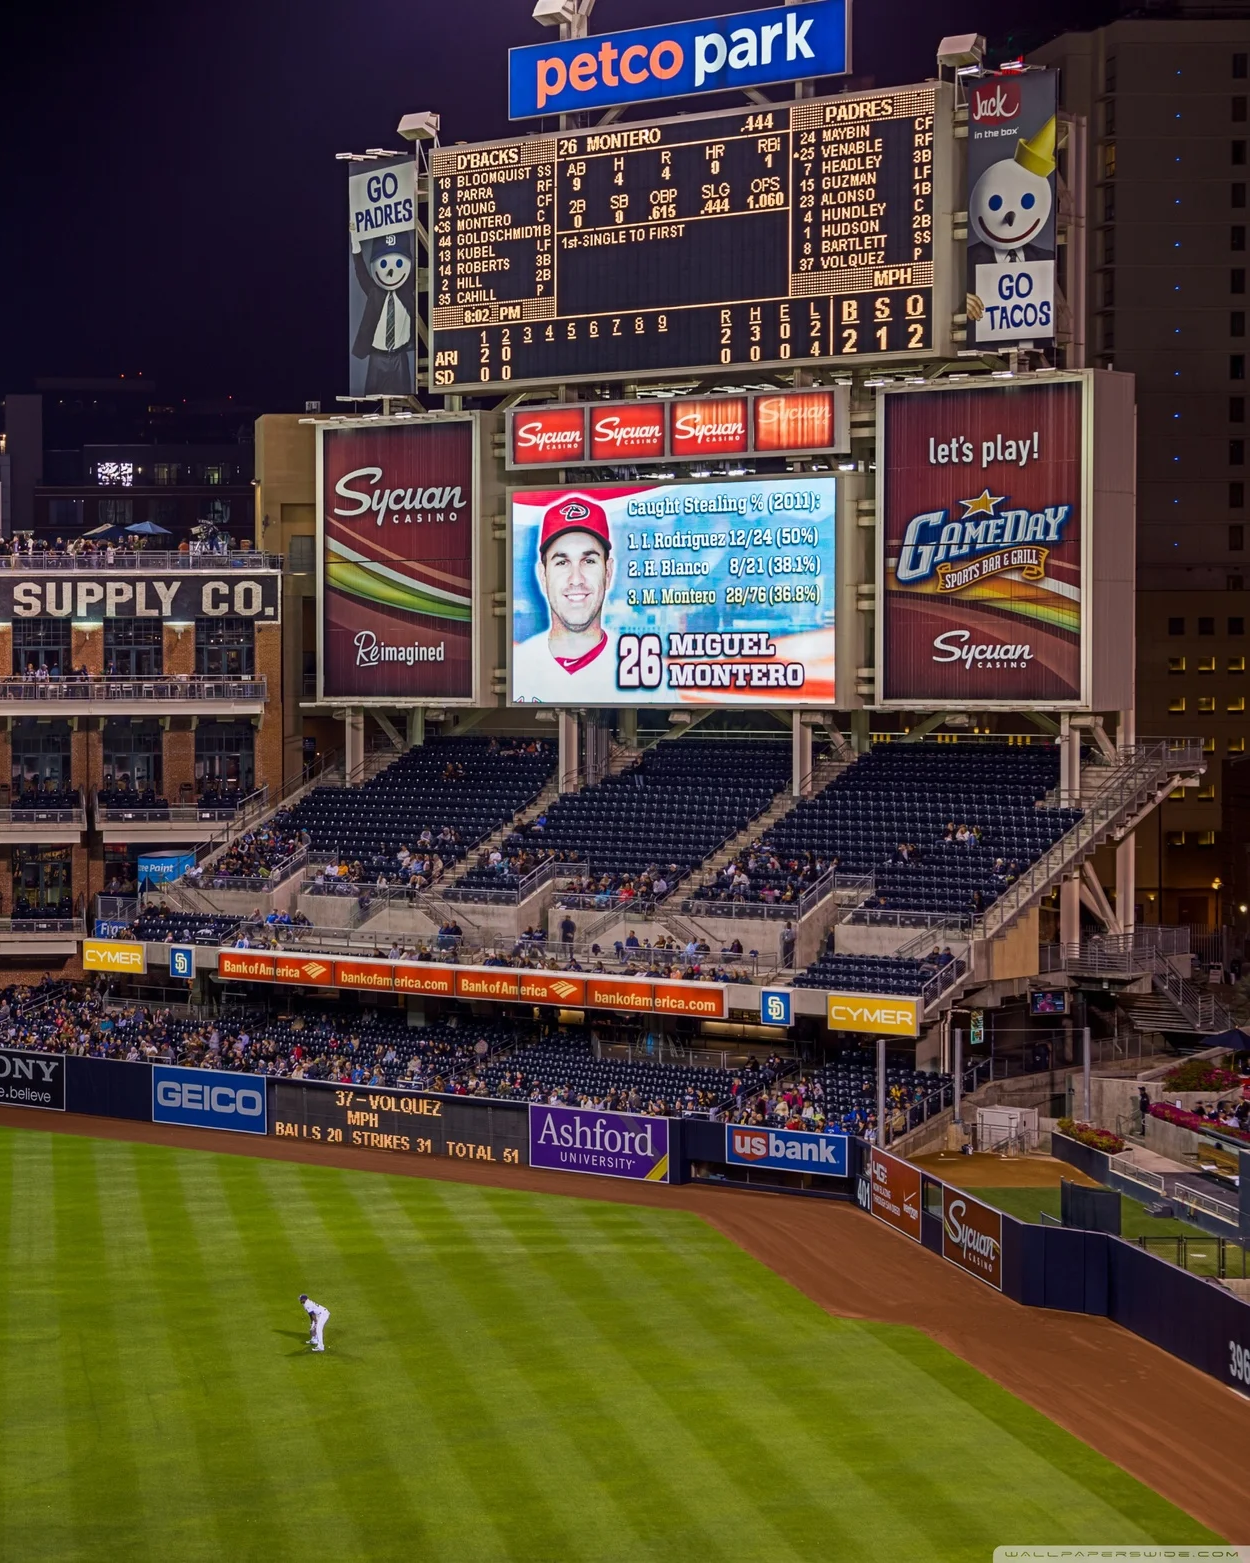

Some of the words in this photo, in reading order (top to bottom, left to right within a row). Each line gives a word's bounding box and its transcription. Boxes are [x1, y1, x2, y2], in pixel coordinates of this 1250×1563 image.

[537, 40, 684, 109] petco
[695, 12, 815, 87] park
[825, 99, 893, 123] PADRES
[972, 84, 1019, 120] Jack
[560, 140, 577, 154] 26
[587, 129, 661, 151] MONTERO
[822, 125, 870, 141] MAYBIN
[821, 139, 882, 158] VENABLE
[457, 149, 518, 171] D'BACKS
[822, 155, 882, 173] HEADLEY
[457, 166, 532, 187] BLOOMQUIST
[822, 172, 876, 190] GUZMAN
[367, 173, 398, 202] GO
[457, 187, 493, 202] PARRA
[821, 188, 875, 206] ALONSO
[355, 199, 413, 232] PADRES
[456, 201, 496, 217] YOUNG
[822, 203, 886, 222] HUNDLEY
[457, 215, 511, 231] MONTERO
[822, 220, 879, 237] HUDSON
[561, 230, 626, 249] 1st-SINGLE
[629, 229, 646, 242] TO
[650, 224, 685, 240] FIRST
[822, 235, 887, 253] BARTLETT
[457, 248, 495, 260] KUBEL
[821, 251, 884, 269] VOLQUEZ
[457, 259, 510, 275] ROBERTS
[874, 268, 912, 287] MPH
[457, 276, 482, 289] HILL
[999, 272, 1033, 300] GO
[457, 290, 497, 304] CAHILL
[464, 309, 489, 323] 8:02
[500, 306, 521, 320] PM
[986, 301, 1050, 330] TACOS
[435, 351, 458, 366] ARI
[435, 370, 454, 385] SD
[758, 398, 831, 431] Sycuan
[518, 422, 582, 451] Sycuan
[595, 417, 662, 446] Sycuan
[675, 414, 745, 444] Sycuan
[929, 435, 973, 464] let's
[982, 432, 1039, 468] play!
[334, 467, 466, 526] Sycuan
[627, 497, 680, 518] Caught
[684, 494, 747, 515] Stealing
[750, 495, 763, 510] %
[769, 492, 820, 513] (2011):
[393, 512, 457, 524] CASINO
[628, 533, 638, 549] 1.
[641, 532, 651, 548] I.
[654, 530, 726, 550] Rodriguez
[729, 527, 773, 548] 12/24
[776, 526, 819, 547] (50%)
[628, 561, 641, 577] 2.
[644, 561, 658, 577] H.
[661, 559, 709, 576] Blanco
[729, 556, 764, 575] 8/21
[768, 555, 820, 575] (38.1%)
[945, 563, 979, 589] SPORTS
[982, 555, 1001, 574] BAR
[1003, 553, 1010, 566] &
[1011, 549, 1038, 565] GRILL
[13, 581, 182, 617] SUPPLY
[202, 580, 274, 616] CO.
[628, 590, 639, 605] 3.
[642, 589, 658, 605] M.
[661, 588, 716, 605] Montero
[726, 586, 766, 606] 28/76
[769, 585, 820, 606] (36.8%)
[354, 630, 444, 667] Reimagined
[669, 633, 776, 656] MIGUEL
[932, 630, 1033, 669] Sycuan
[618, 635, 662, 688] 26
[669, 662, 805, 688] MONTERO
[150, 863, 174, 872] Paint
[85, 951, 141, 965] CYMER
[224, 960, 247, 974] Bank
[249, 962, 259, 976] of
[259, 963, 300, 978] America
[341, 972, 448, 991] bankofamerica.com
[461, 979, 488, 993] Bank
[489, 980, 501, 994] of
[500, 981, 548, 997] America
[594, 991, 715, 1012] bankofamerica.com
[831, 1006, 913, 1025] CYMER
[157, 1081, 262, 1117] GEICO
[347, 1111, 379, 1128] MPH
[537, 1113, 654, 1157] Ashford
[327, 1128, 343, 1143] 20
[352, 1131, 410, 1152] STRIKES
[417, 1138, 432, 1154] 31
[446, 1141, 496, 1162] TOTAL
[503, 1148, 519, 1164] 51
[560, 1151, 633, 1170] UNIVERSITY
[857, 1178, 870, 1209] 401
[949, 1200, 996, 1260] Sycuan
[968, 1255, 992, 1272] CASINO
